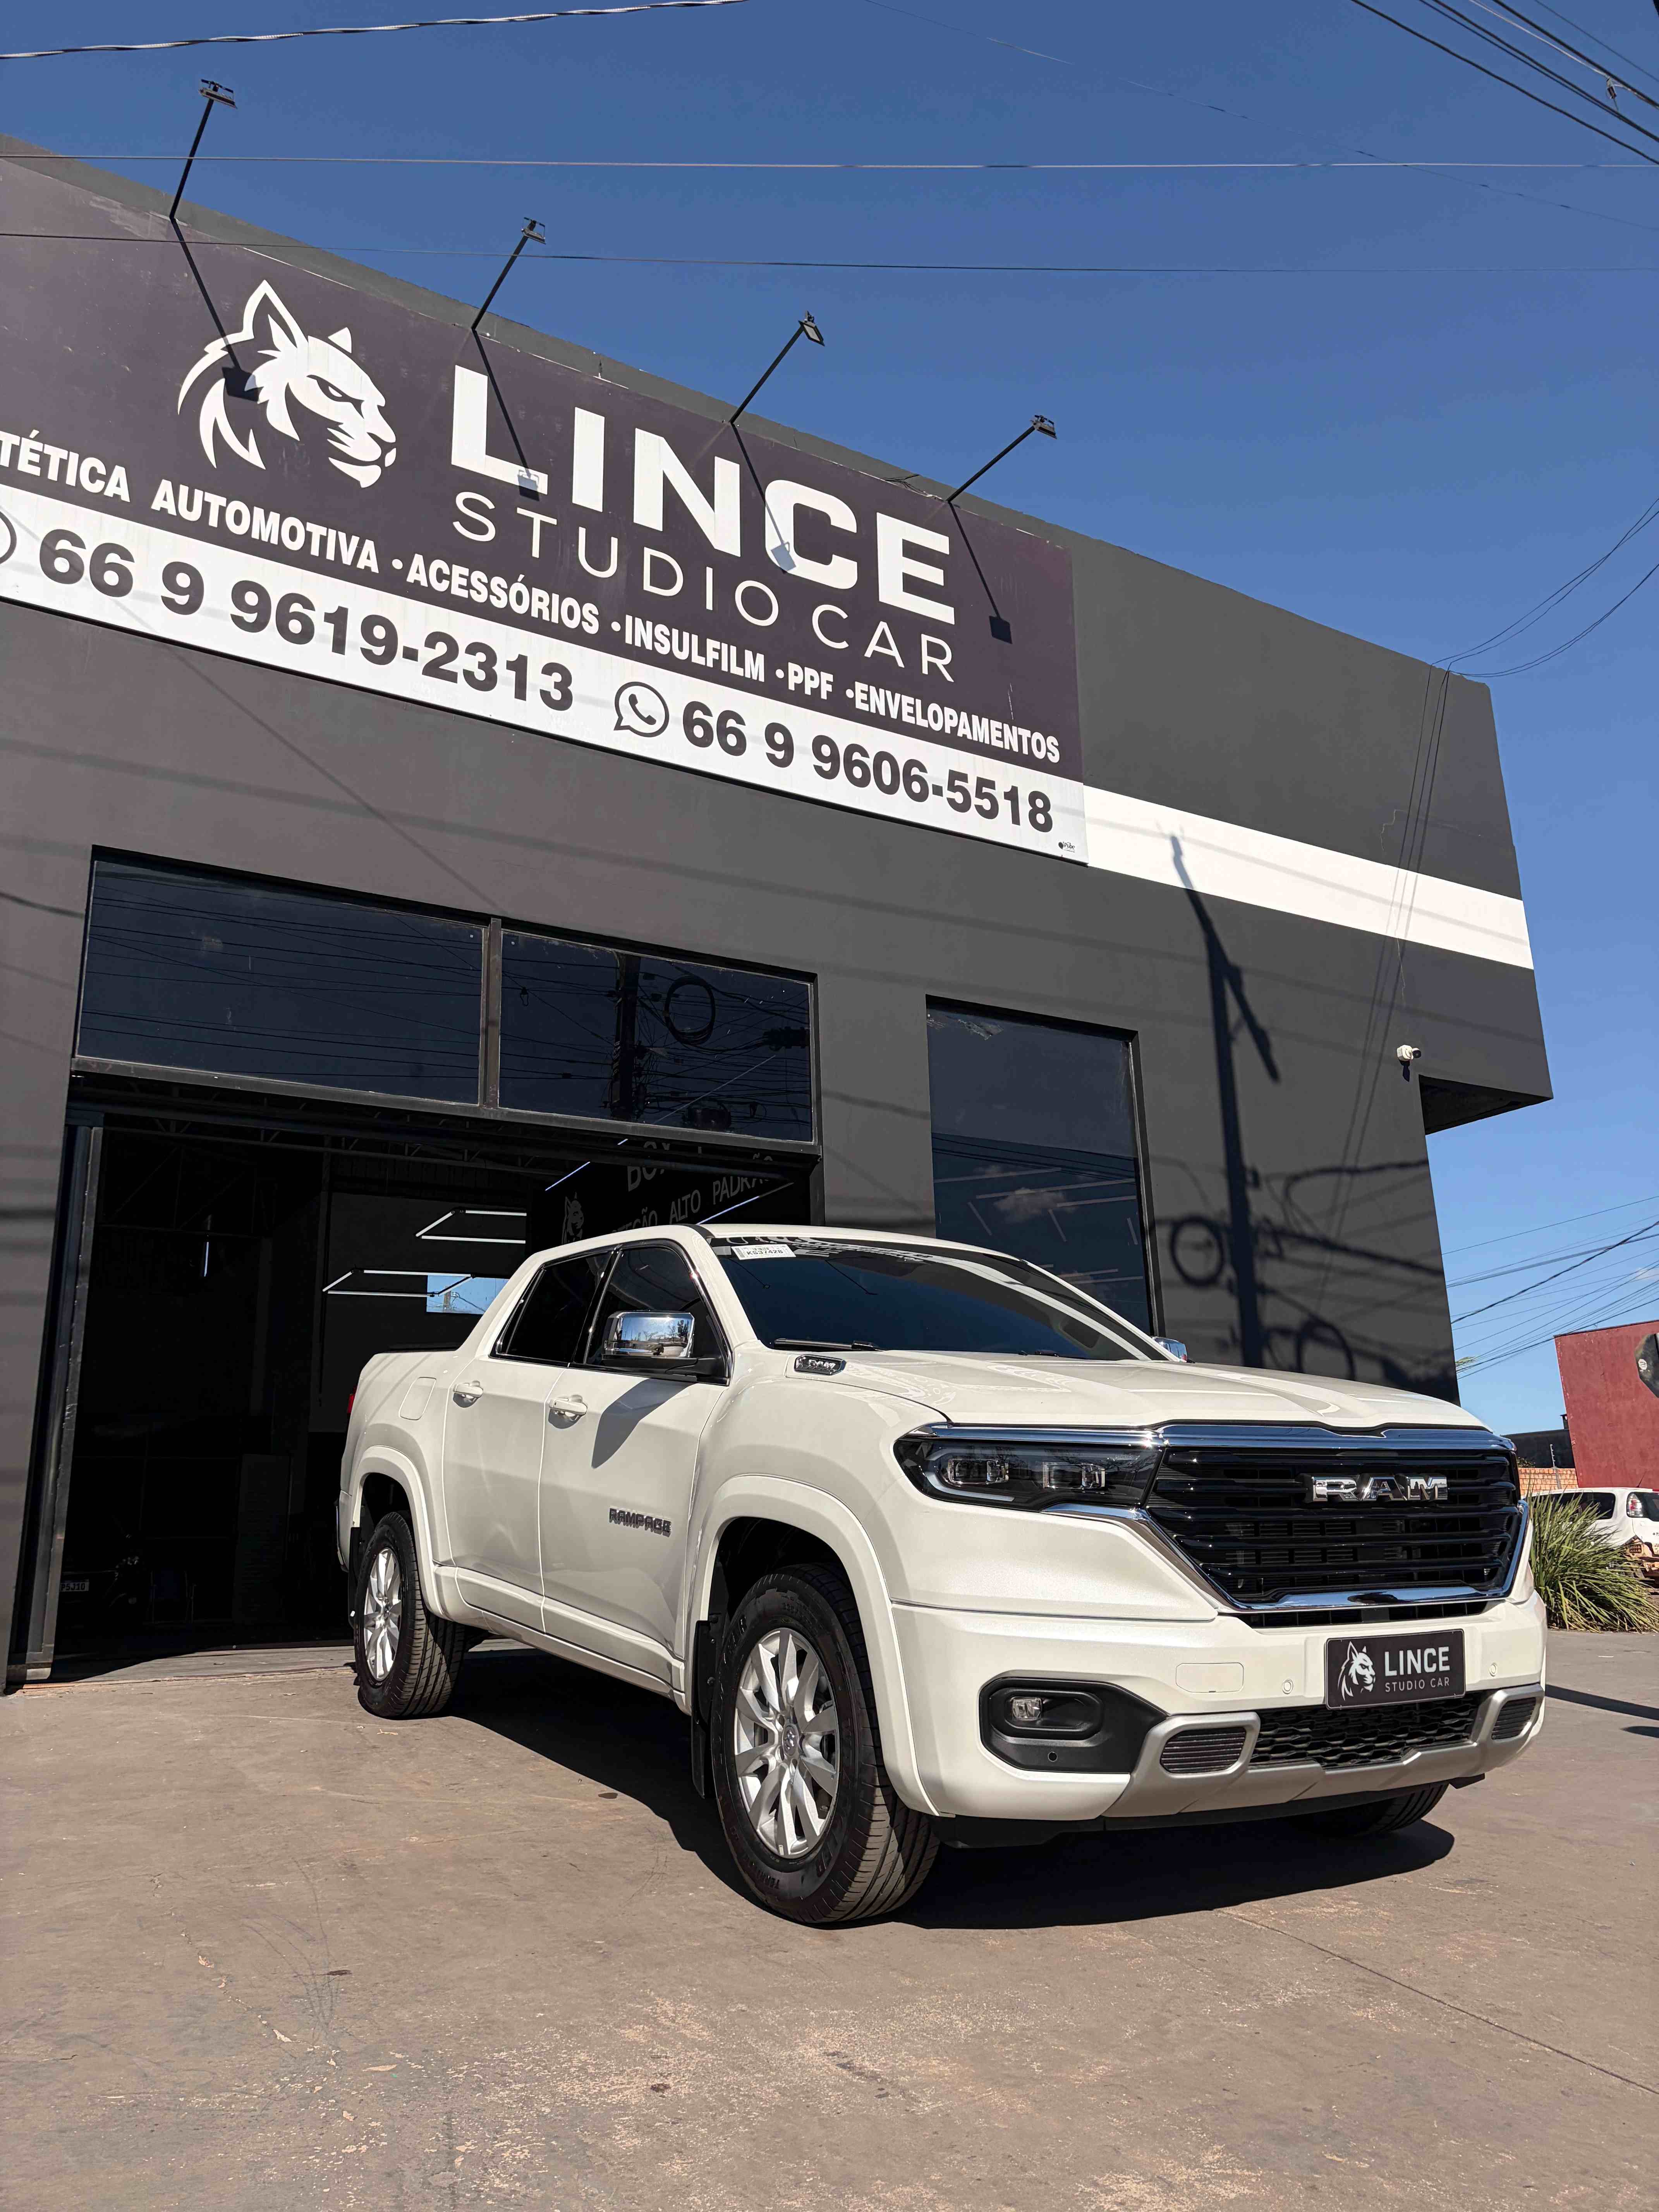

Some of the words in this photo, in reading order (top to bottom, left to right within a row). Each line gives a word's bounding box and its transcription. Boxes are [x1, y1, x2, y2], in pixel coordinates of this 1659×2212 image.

[151, 479, 379, 574] AUTOMOTIVA
[451, 365, 955, 625] LINCE
[453, 491, 779, 627] STUDIO
[812, 605, 955, 682] CAR
[40, 529, 135, 598] 66
[161, 562, 204, 615] 9
[230, 580, 573, 711] 9619-2313
[683, 701, 747, 756] 66
[764, 722, 794, 768] 9
[812, 735, 1053, 833] 9606-5518
[669, 1189, 701, 1224] ALTO
[1312, 1476, 1448, 1501] RAM
[609, 1508, 672, 1536] RAMPAGE
[1384, 1646, 1450, 1676] LINCE
[1385, 1680, 1425, 1692] STUDIO
[1430, 1677, 1449, 1688] CAR
